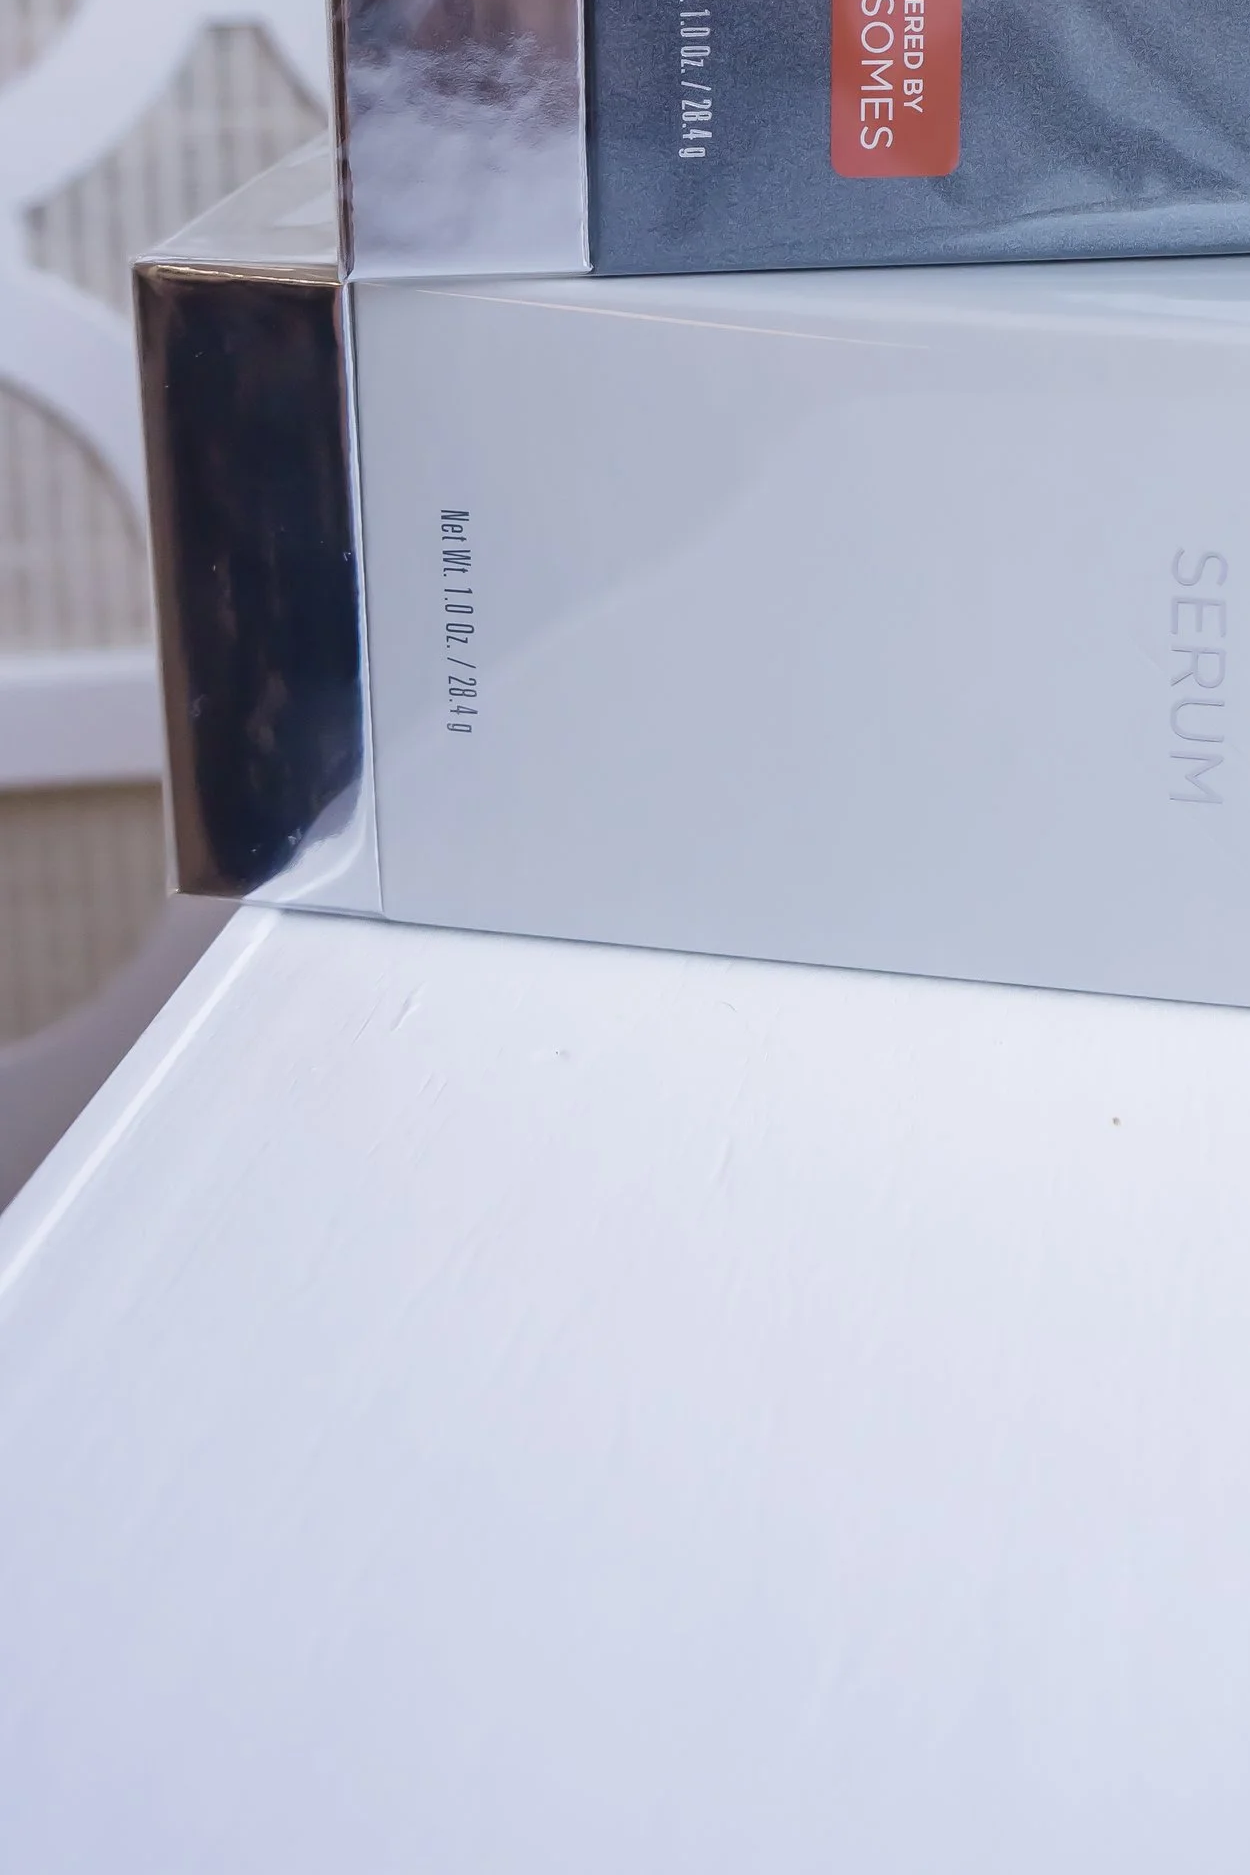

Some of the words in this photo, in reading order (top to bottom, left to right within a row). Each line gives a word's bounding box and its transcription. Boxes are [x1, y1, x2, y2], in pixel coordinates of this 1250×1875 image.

[680, 9, 711, 38] 1.0
[680, 45, 712, 74] Oz.
[681, 81, 712, 92] /
[903, 78, 924, 113] BY
[681, 98, 713, 140] 28.4
[678, 146, 706, 159] g
[440, 508, 470, 544] Net
[441, 547, 472, 578] Wt.
[443, 588, 474, 615] 1.0
[445, 622, 475, 650] Oz.
[447, 657, 477, 670] /
[1168, 546, 1229, 805] SERUM
[447, 676, 478, 716] 28.4
[447, 722, 472, 735] g
